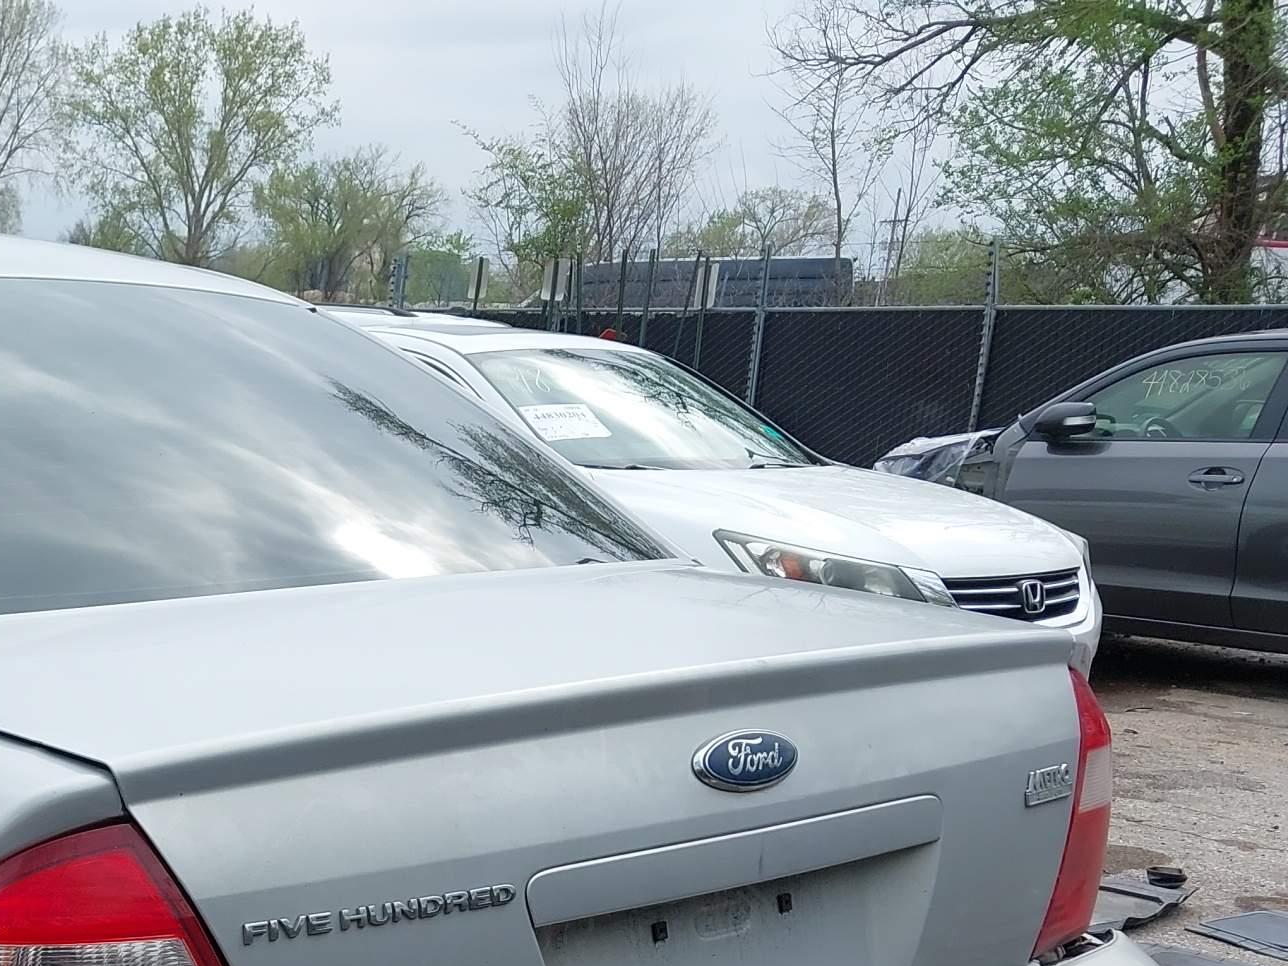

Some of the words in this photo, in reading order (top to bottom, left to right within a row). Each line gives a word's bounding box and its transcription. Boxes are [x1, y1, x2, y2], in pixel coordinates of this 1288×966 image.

[727, 736, 783, 775] Ford
[242, 911, 332, 945] FIVE
[339, 883, 516, 931] HUNDRED
